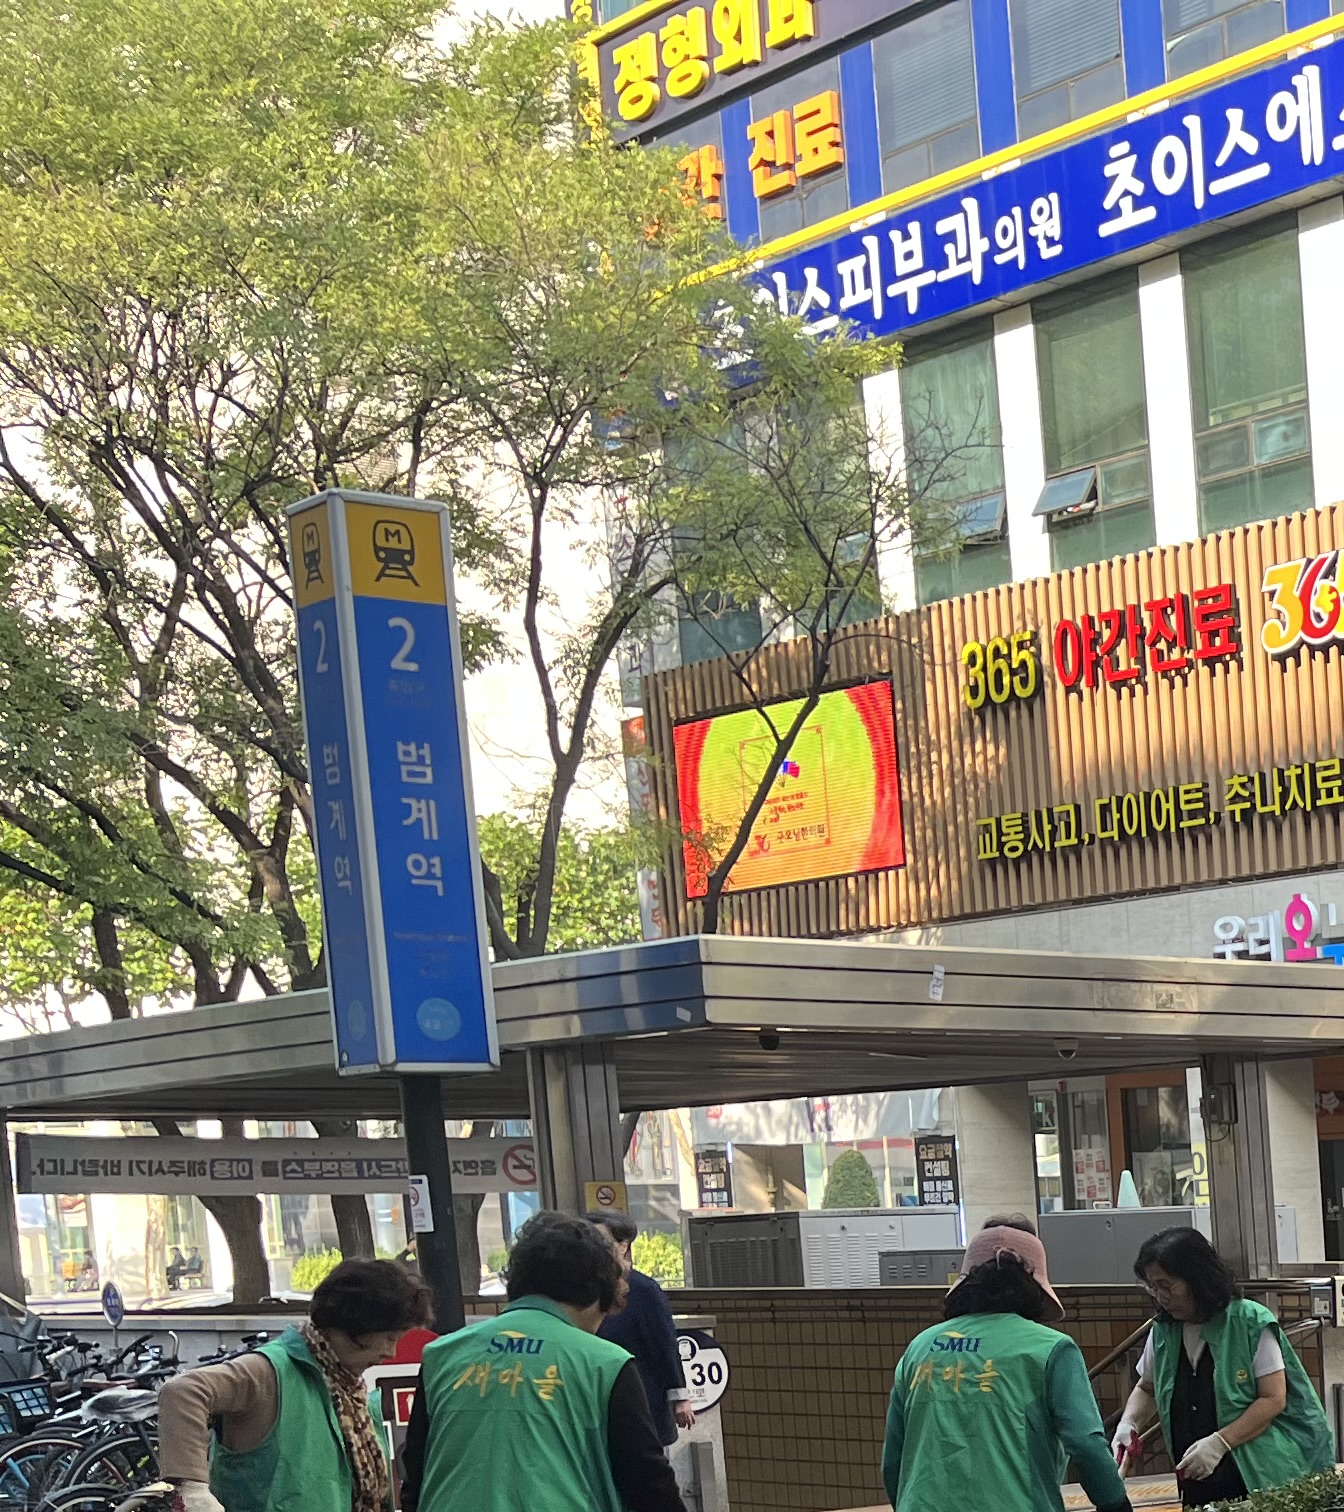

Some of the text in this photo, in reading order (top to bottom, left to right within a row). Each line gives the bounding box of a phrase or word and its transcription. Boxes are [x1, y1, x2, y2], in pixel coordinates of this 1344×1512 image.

[746, 89, 845, 199] 진료
[313, 618, 329, 674] 2
[387, 616, 420, 673] 2
[961, 583, 1239, 711] 365 야간진료
[322, 741, 353, 897] 범계역
[396, 740, 444, 897] 범계역
[975, 802, 1090, 862] 교통사고,
[487, 1336, 544, 1355] SMU
[930, 1337, 982, 1354] SMU
[453, 1360, 564, 1402] 새마을
[690, 1361, 724, 1388] 30
